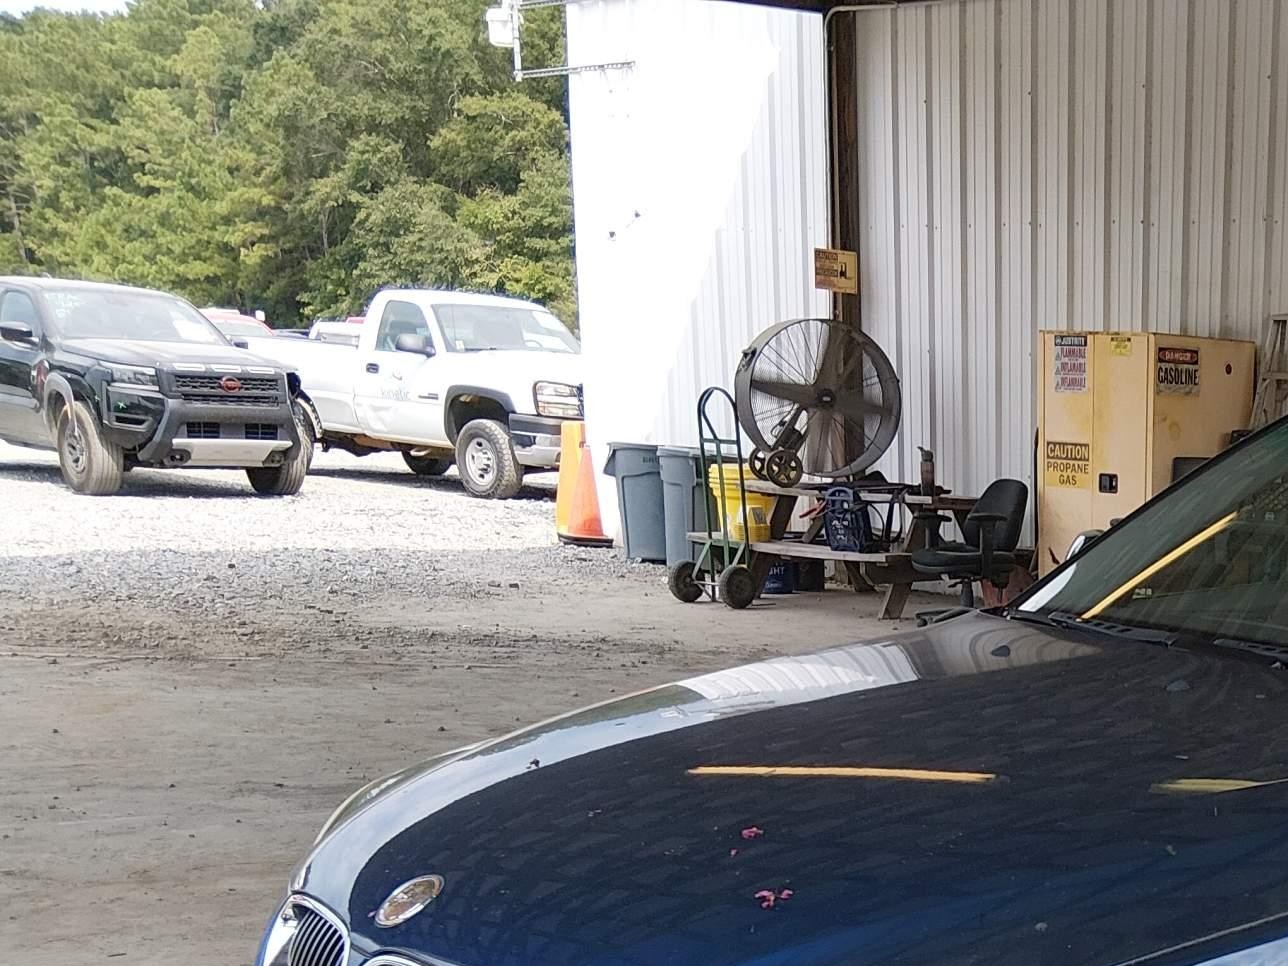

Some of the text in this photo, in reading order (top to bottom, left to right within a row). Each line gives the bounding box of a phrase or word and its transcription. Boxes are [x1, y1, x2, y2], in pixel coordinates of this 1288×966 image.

[1165, 350, 1192, 361] DANGER
[1158, 366, 1198, 386] GASOLINE
[1048, 443, 1088, 460] CAUTION
[1047, 461, 1089, 474] PROPANE
[1059, 474, 1077, 485] GAS
